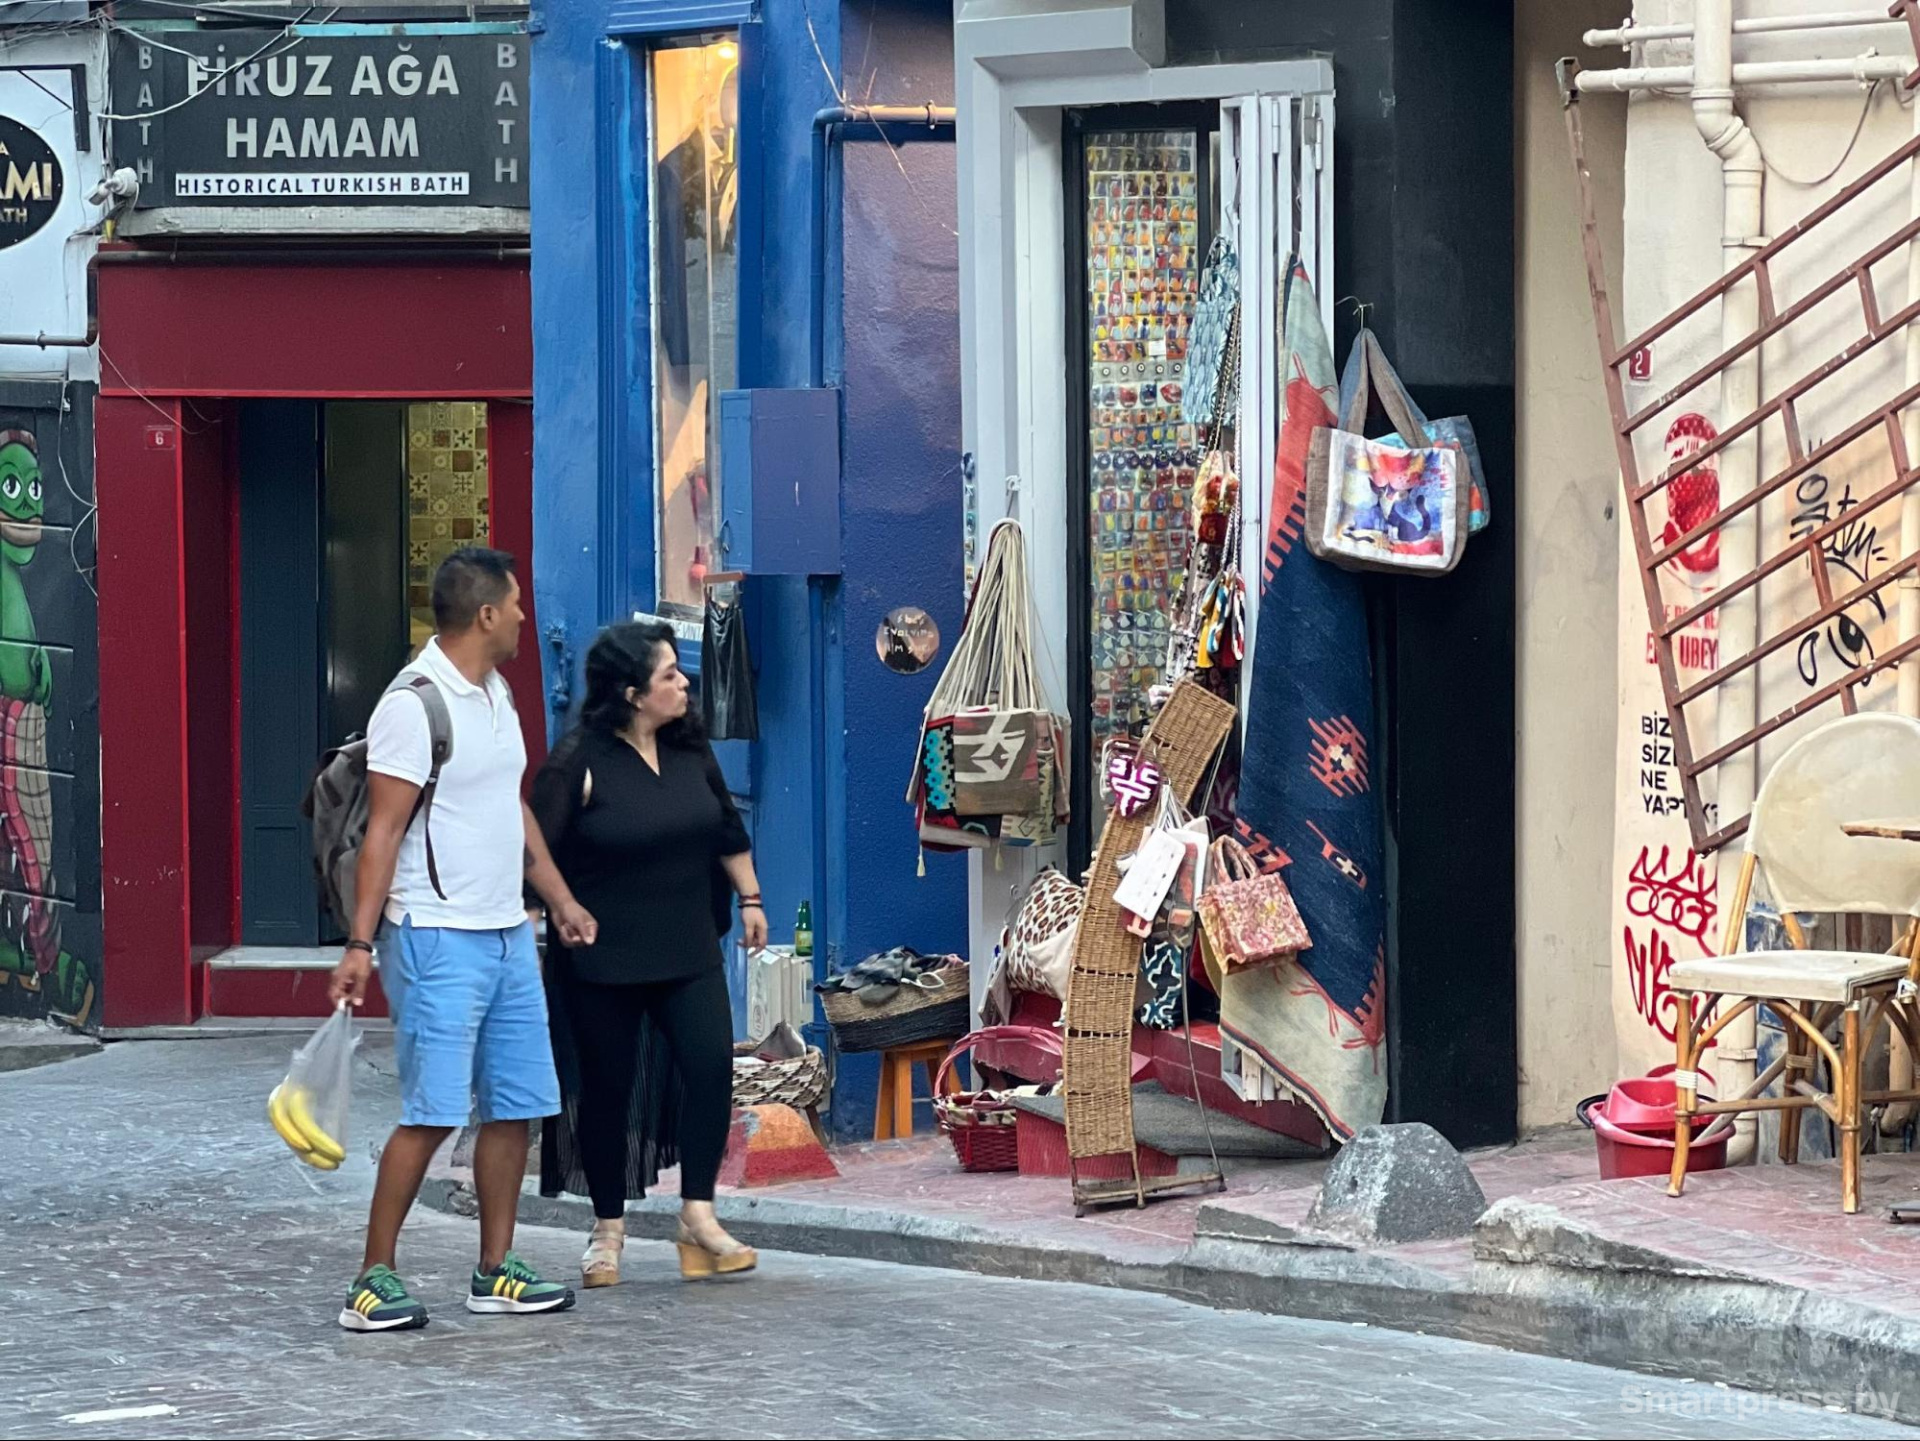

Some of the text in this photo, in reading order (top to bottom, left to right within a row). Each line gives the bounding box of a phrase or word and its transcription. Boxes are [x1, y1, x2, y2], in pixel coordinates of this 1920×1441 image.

[187, 43, 460, 97] FİRUZ AĞA
[137, 44, 154, 184] BATH
[494, 43, 519, 183] BATH
[227, 117, 420, 159] HAMAM
[177, 175, 463, 194] HISTORICAL TURKISH BATH
[1635, 350, 1643, 375] 2
[155, 431, 164, 446] 6
[1641, 710, 1673, 738] BİZ
[1641, 769, 1667, 791] NE
